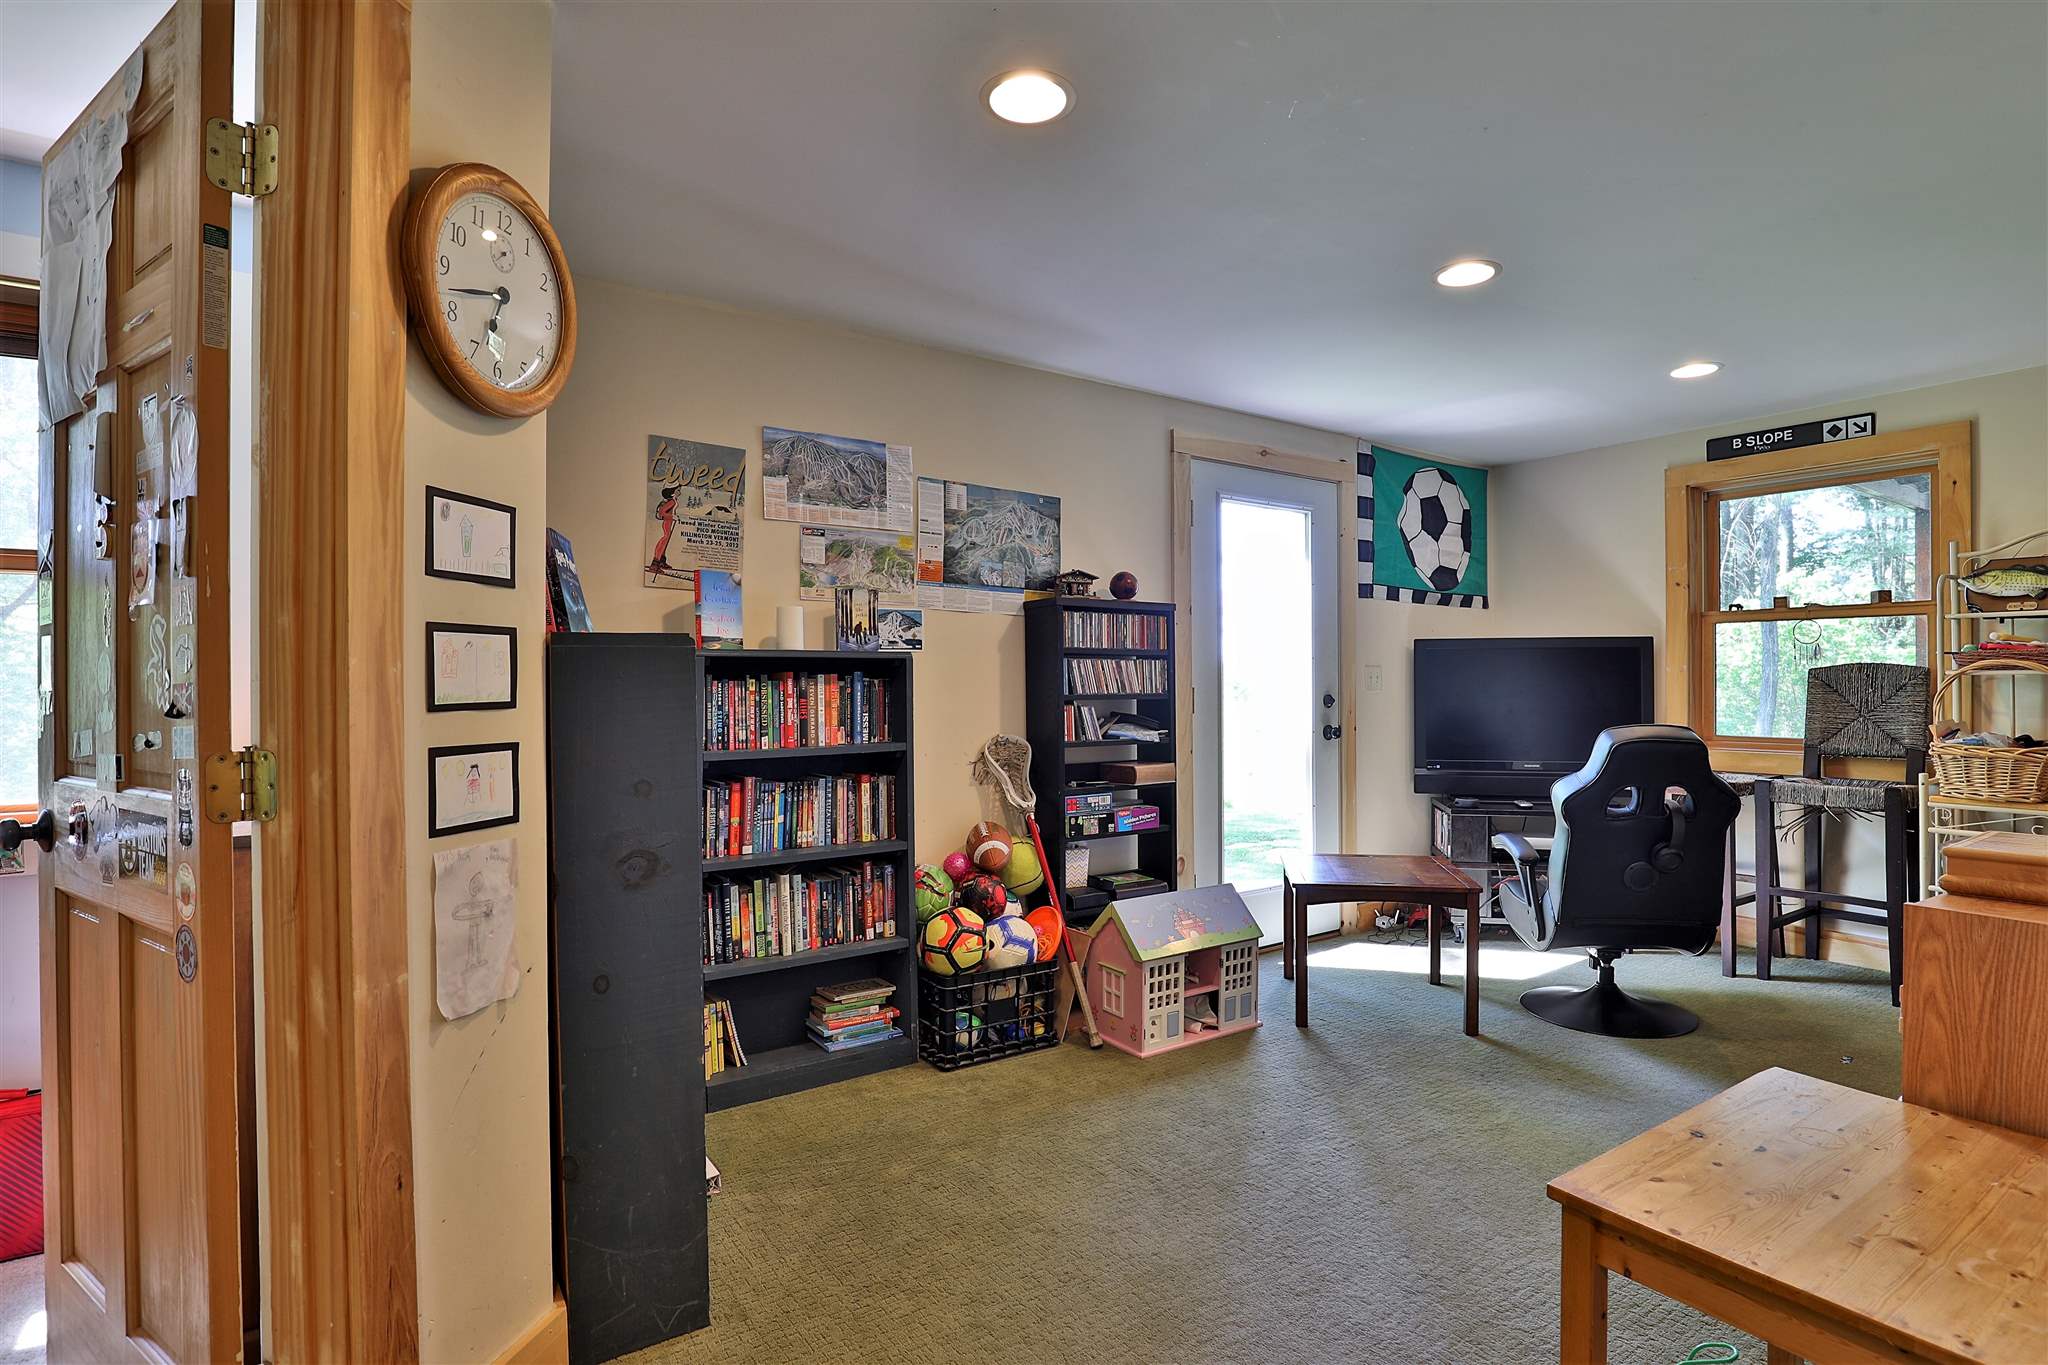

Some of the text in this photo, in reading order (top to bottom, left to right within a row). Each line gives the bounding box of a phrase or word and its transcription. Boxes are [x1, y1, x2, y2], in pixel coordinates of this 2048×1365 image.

[472, 206, 485, 229] 11
[497, 211, 513, 235] 12
[451, 222, 466, 248] 10
[524, 238, 530, 256] 1
[439, 255, 450, 275] 9
[540, 273, 548, 291] 2
[447, 301, 458, 321] 8
[544, 313, 553, 330] 3
[469, 340, 480, 359] 7
[536, 345, 544, 361] 4
[493, 361, 502, 379] 6
[1733, 430, 1793, 449] B SLOPE
[652, 442, 746, 507] tweed
[698, 521, 716, 529] Winter
[717, 523, 740, 531] Carnival
[711, 528, 740, 537] MOUNTAIN
[681, 531, 712, 540] KILLINGTON
[800, 698, 808, 720] ALLIES
[1123, 816, 1140, 825] Hidden
[1139, 812, 1157, 820] Pictures
